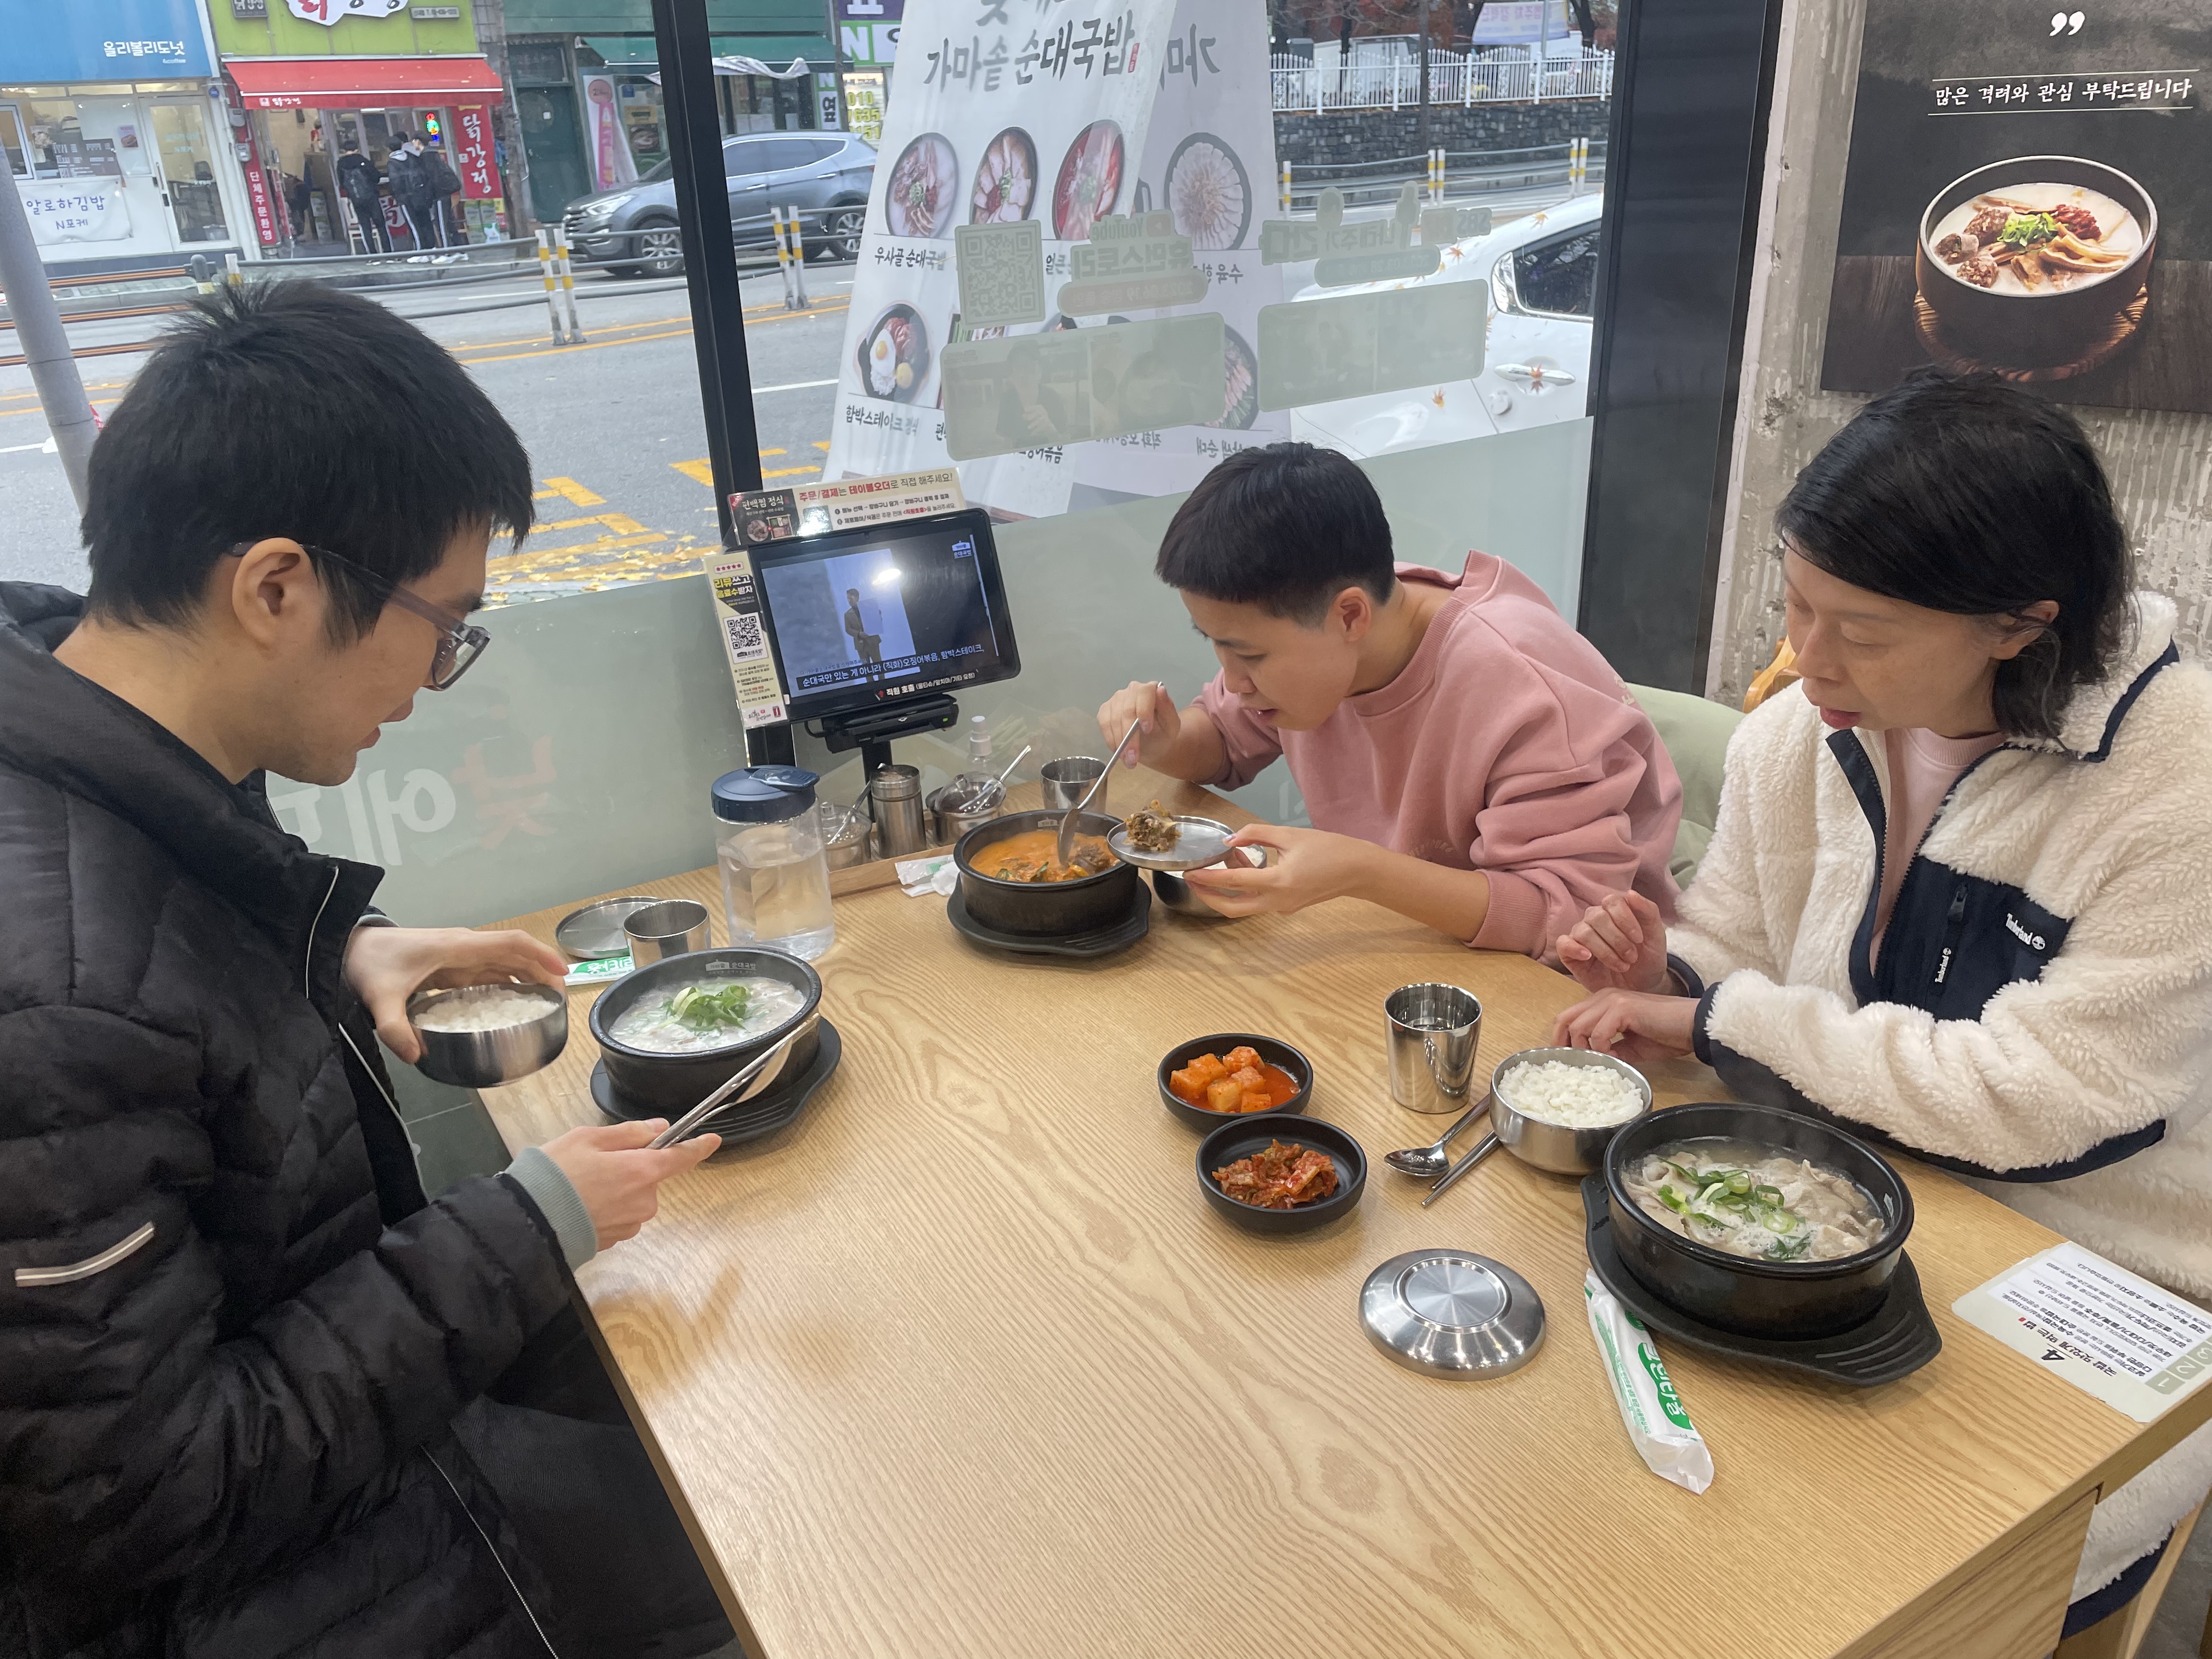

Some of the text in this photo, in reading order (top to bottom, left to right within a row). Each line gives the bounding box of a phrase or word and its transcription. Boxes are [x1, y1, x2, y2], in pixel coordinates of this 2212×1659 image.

[104, 41, 184, 57] 올리볼리도넛
[924, 36, 1010, 93] 가마솥
[1015, 9, 1135, 85] 순대국밥
[847, 91, 874, 106] 010
[1936, 77, 2193, 105] 많은 격려와 관심 부탁드립니다
[462, 113, 492, 194] 닭강정
[26, 195, 105, 215] 알로하김밥
[250, 171, 273, 241] 단체주문환영
[56, 219, 88, 230] N포케
[874, 246, 905, 267] 우사골
[846, 405, 904, 431] 함박스테이크
[799, 472, 953, 502] 주문/결제는 테이블오더로 직접 해주세요!
[742, 497, 766, 511] 편백찜
[768, 495, 784, 507] 정식
[714, 574, 751, 589] 리뷰쓰고
[803, 644, 985, 687] 순대국만 있는 게 아니라 (직화)오징어볶음, 함박스테이크,
[887, 686, 900, 697] 직원
[902, 684, 915, 693] 호출
[2006, 912, 2033, 945] Timberland
[2022, 1319, 2118, 1378] 국밥 맛있게 먹는 법
[2038, 1347, 2067, 1367] 4
[2176, 1359, 2197, 1377] 2
